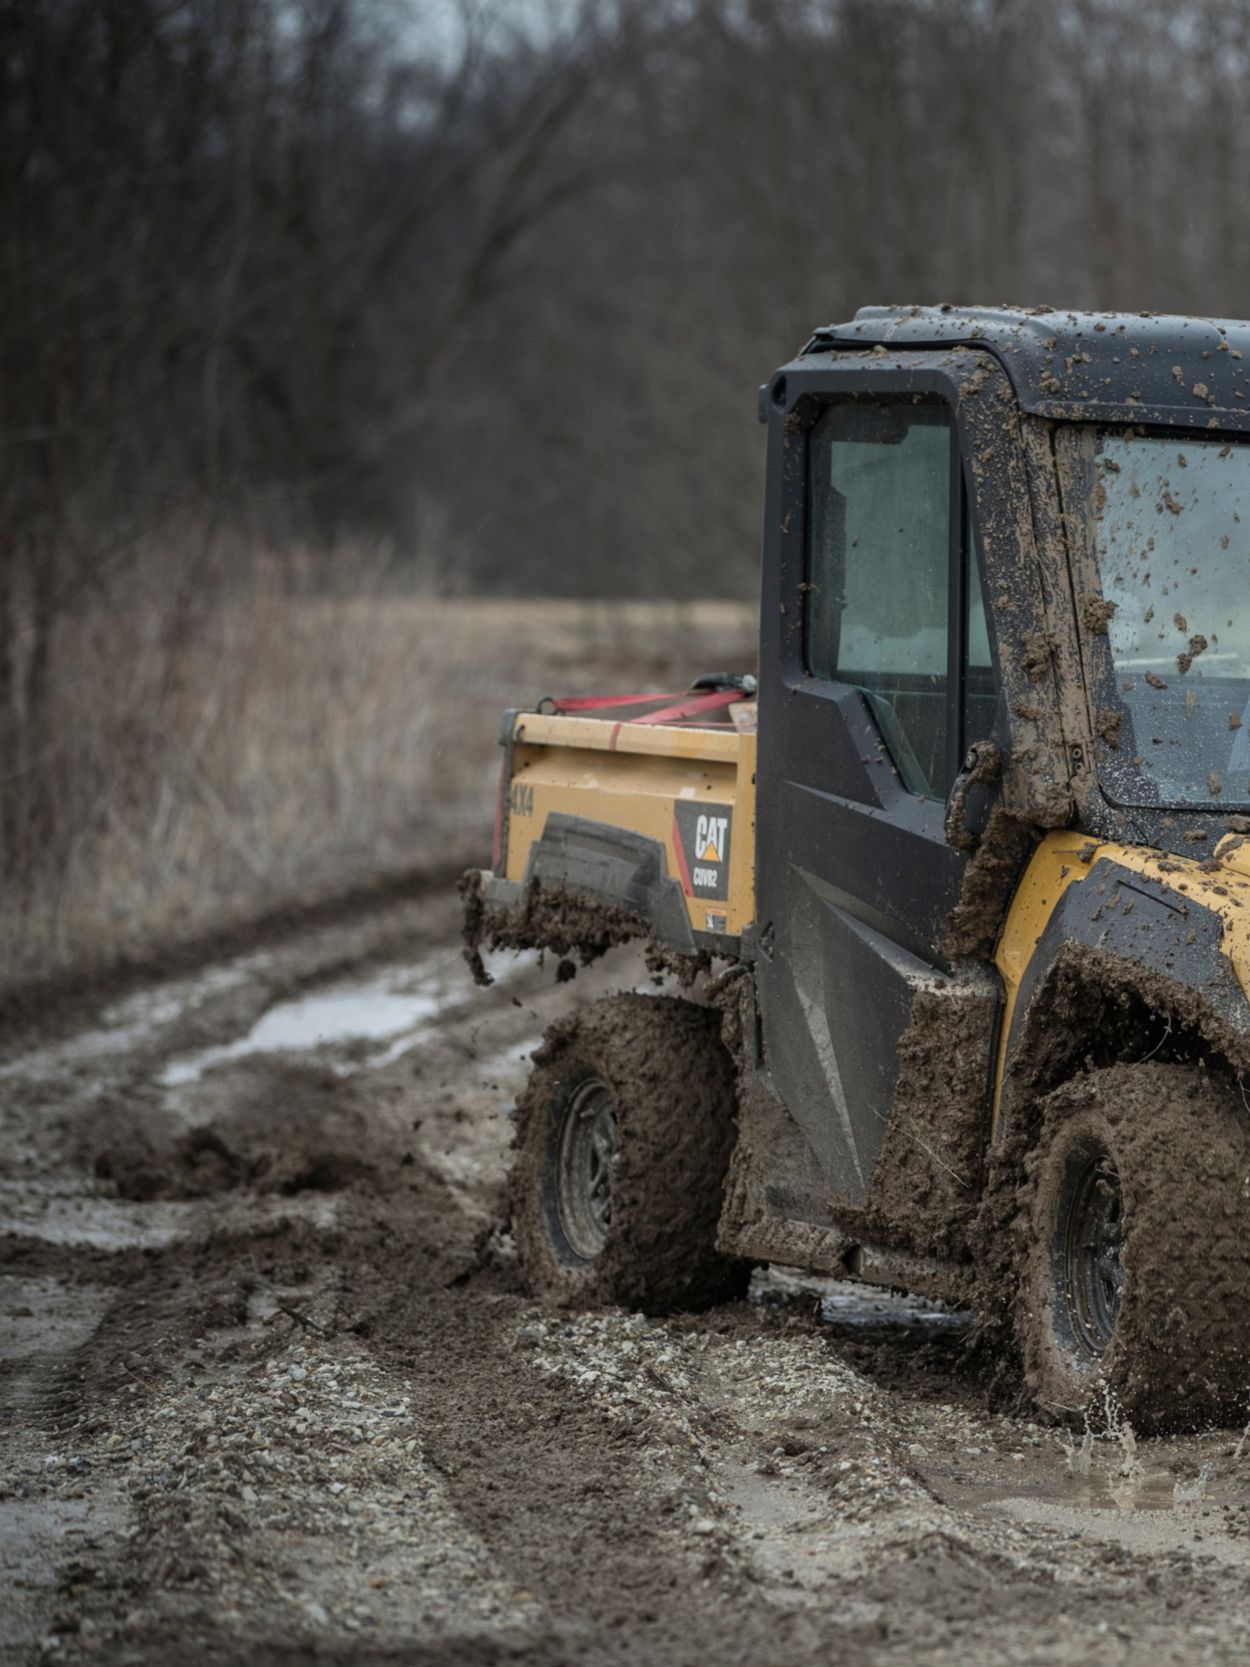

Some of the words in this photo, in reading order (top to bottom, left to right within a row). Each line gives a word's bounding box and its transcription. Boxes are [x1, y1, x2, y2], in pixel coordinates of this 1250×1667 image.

[510, 784, 534, 816] 4X4
[695, 815, 728, 862] CAT
[693, 867, 718, 888] CUV82
